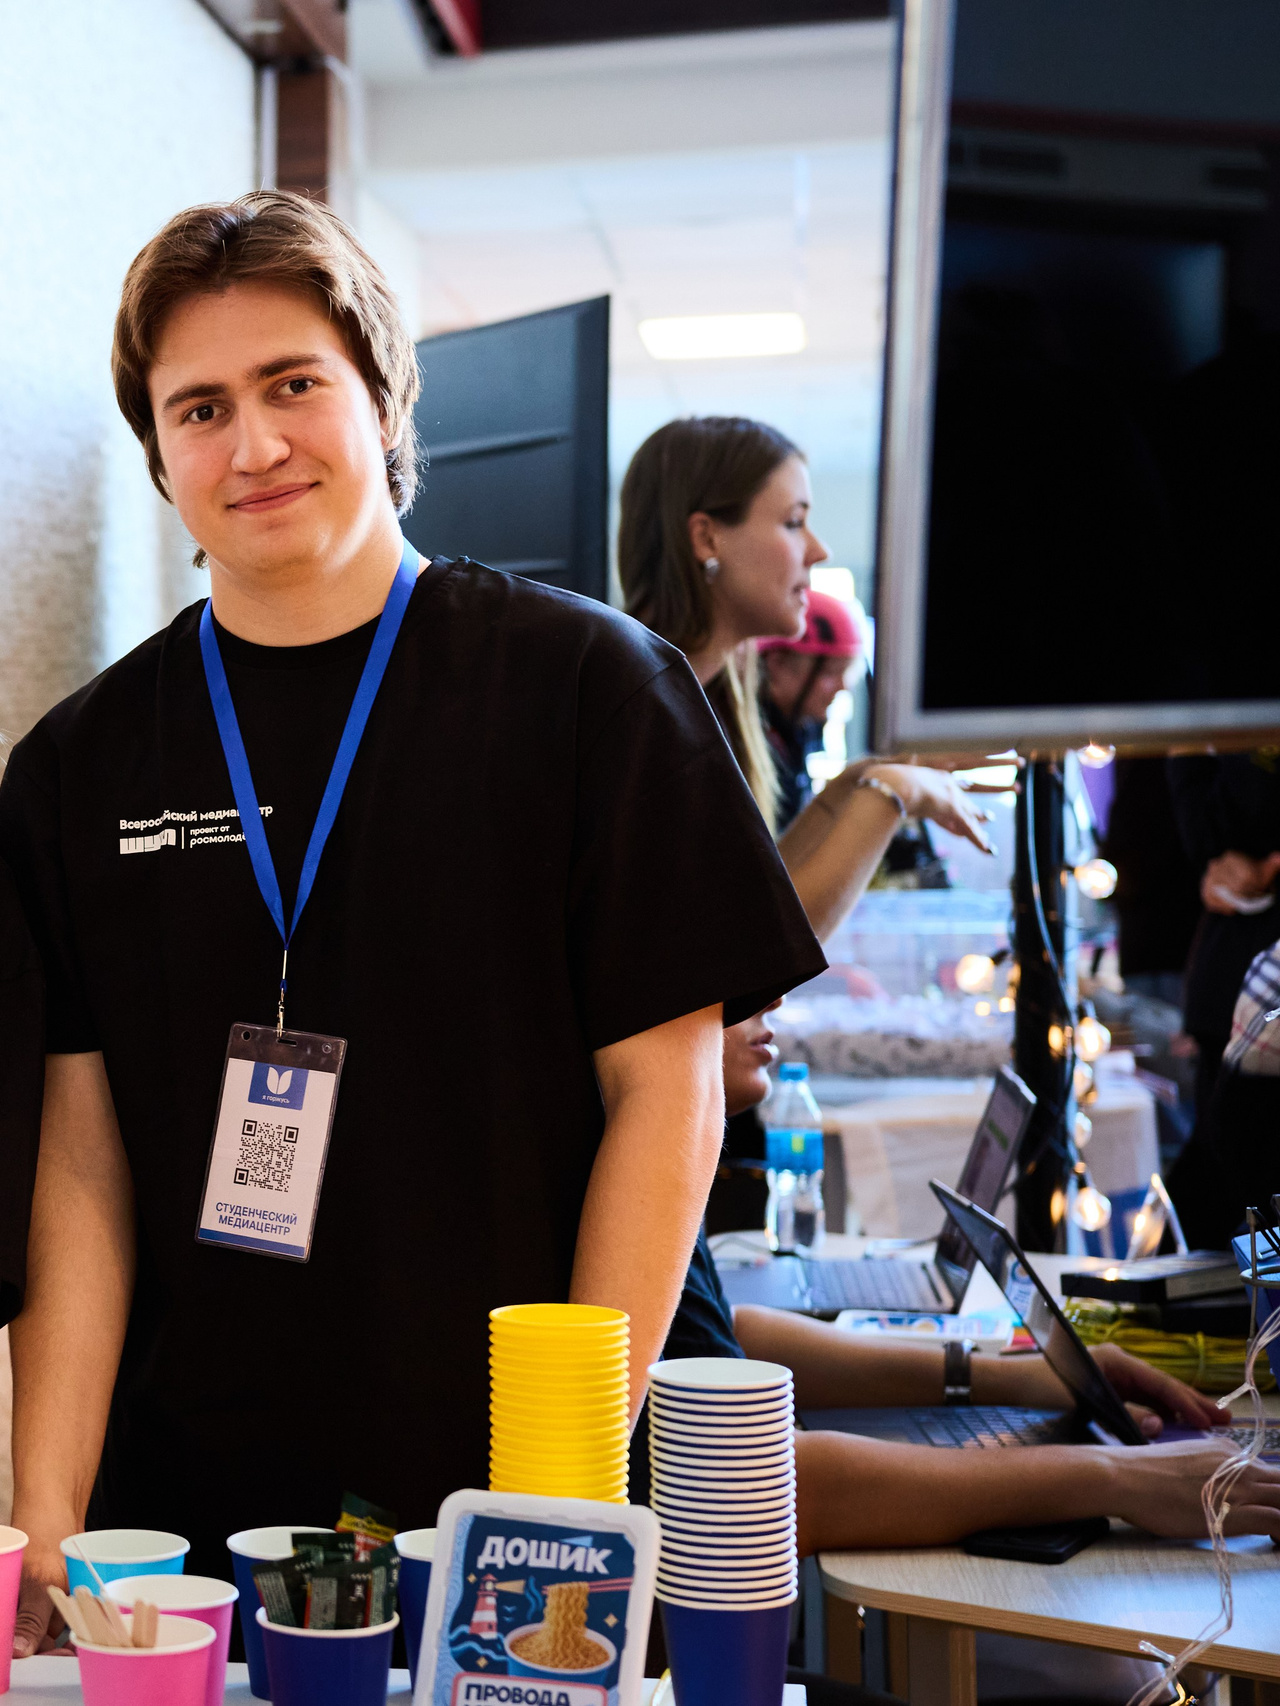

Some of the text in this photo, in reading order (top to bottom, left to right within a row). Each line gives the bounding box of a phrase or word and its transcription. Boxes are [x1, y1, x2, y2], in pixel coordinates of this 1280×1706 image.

[200, 806, 273, 820] медиатр
[190, 827, 219, 836] проект
[190, 832, 246, 848] росмолод
[216, 1202, 297, 1225] СТУДЕНЧЕСКИЙ
[219, 1215, 290, 1235] МЕДИАЦЕНТР
[477, 1535, 613, 1575] ДОШИК
[465, 1683, 570, 1706] ПРОВОДА
